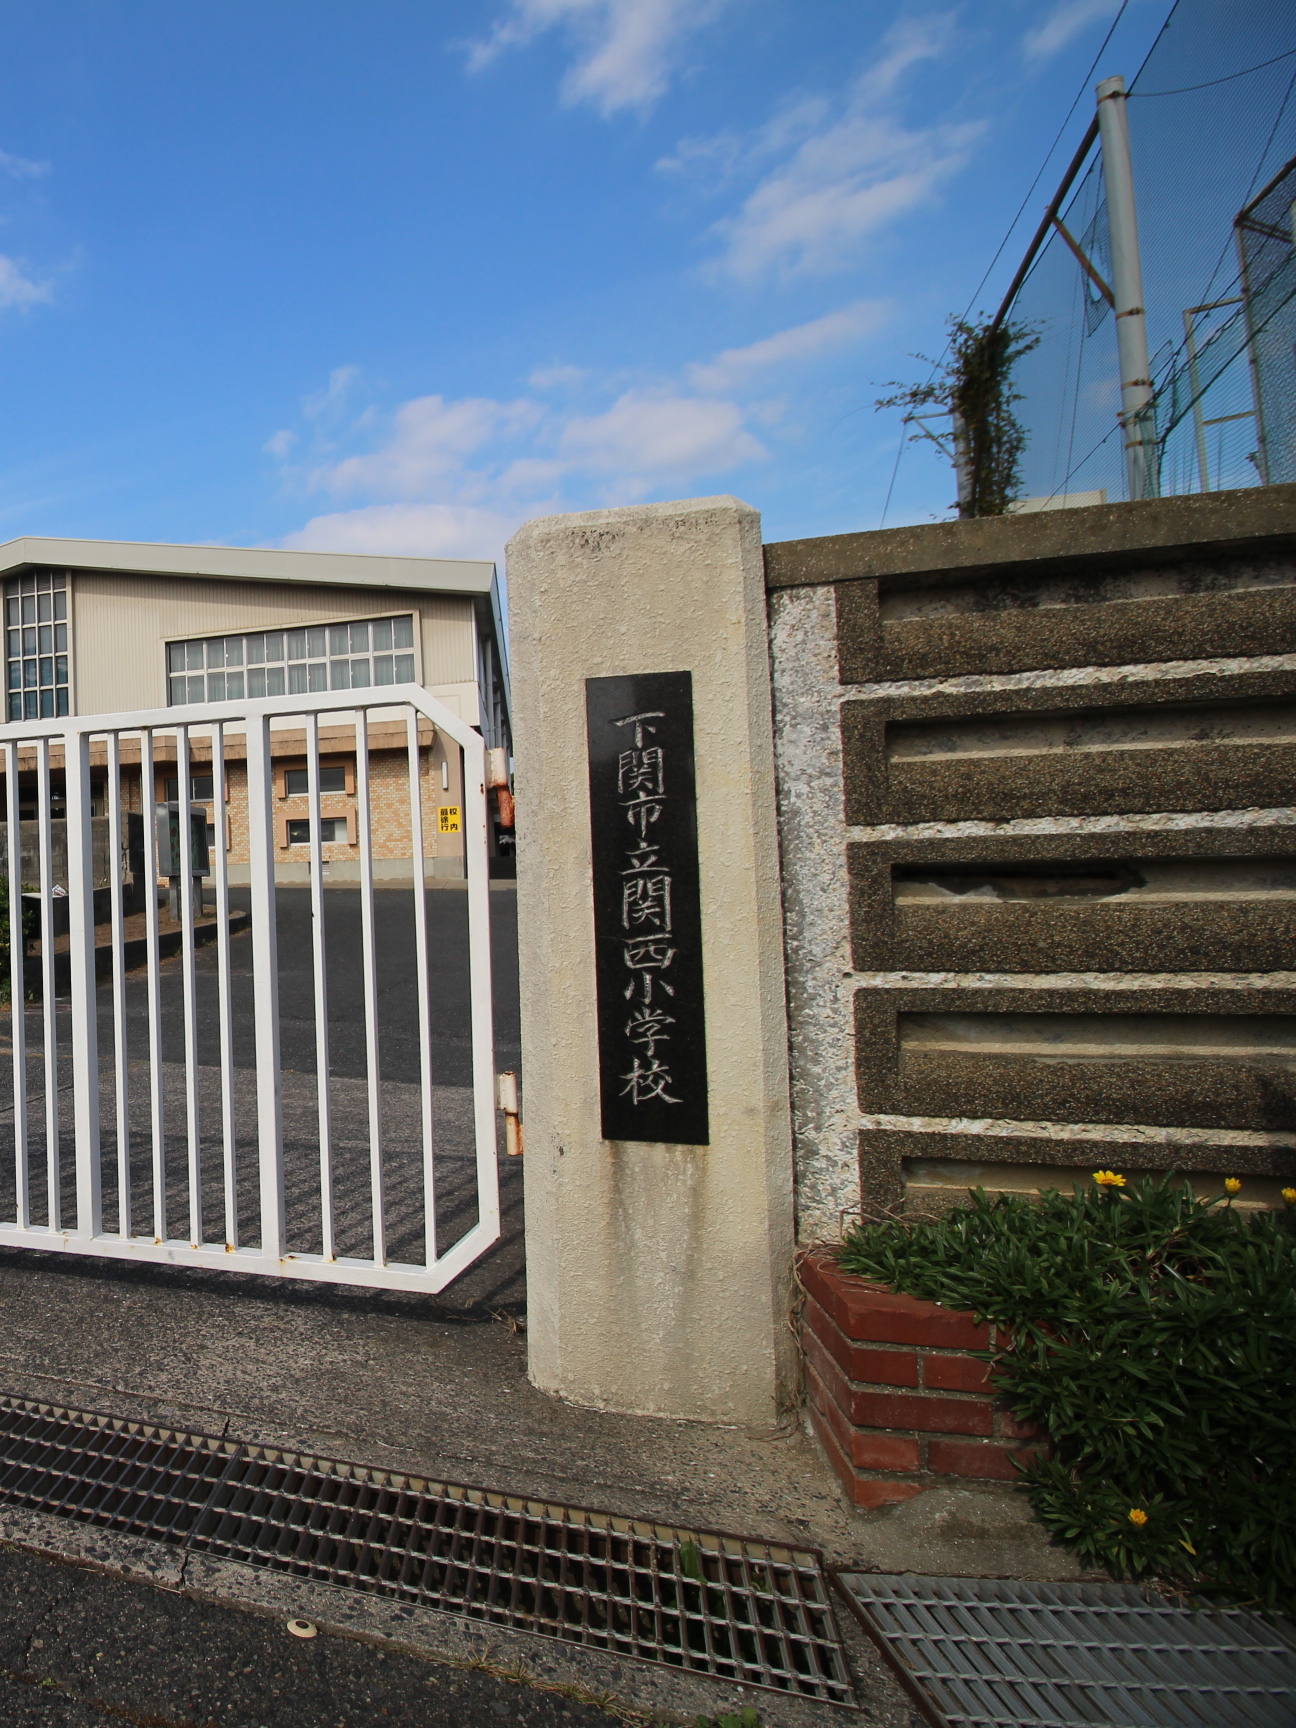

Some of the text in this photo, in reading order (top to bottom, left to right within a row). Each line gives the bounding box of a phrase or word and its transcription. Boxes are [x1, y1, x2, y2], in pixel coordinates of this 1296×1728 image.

[449, 807, 458, 831] 校内
[610, 711, 684, 1105] 下関市立関西小学校
